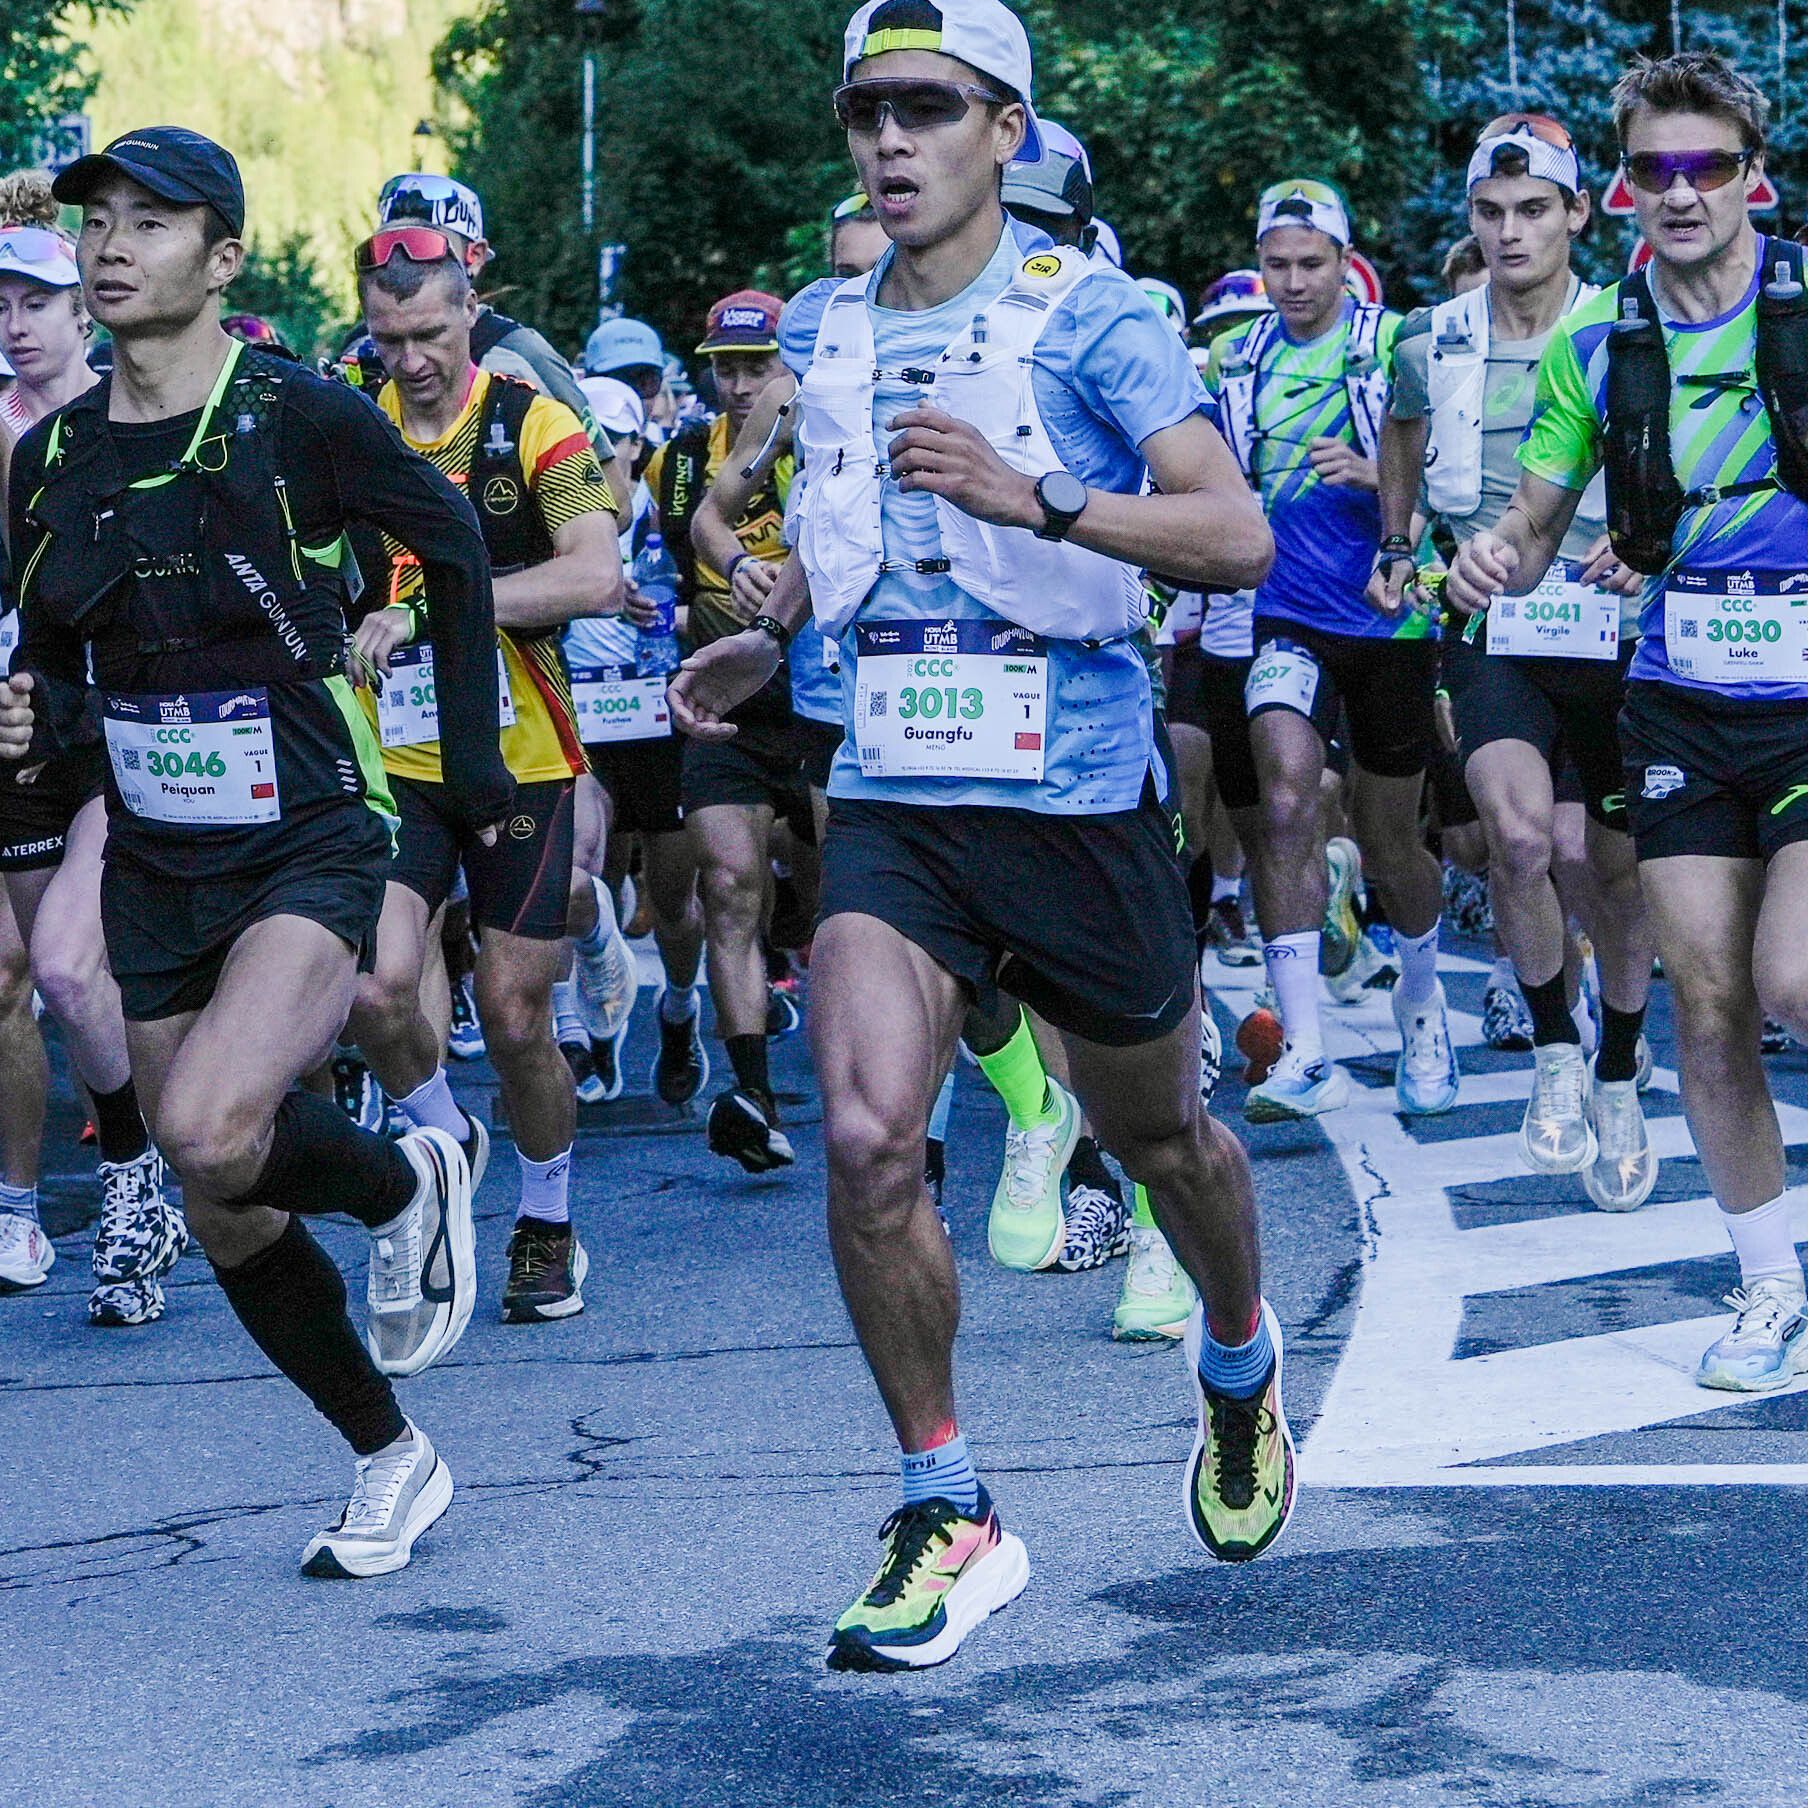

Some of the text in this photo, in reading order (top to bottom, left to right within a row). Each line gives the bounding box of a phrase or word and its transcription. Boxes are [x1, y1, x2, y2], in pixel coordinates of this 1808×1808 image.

[223, 553, 268, 593] ANTA
[1536, 585, 1564, 596] CCC
[1727, 580, 1755, 590] UTMB
[1523, 601, 1581, 623] 3041
[1721, 599, 1753, 613] CCC
[1535, 625, 1570, 637] Virgile
[1706, 618, 1782, 643] 3030
[923, 633, 958, 645] UTMB
[1728, 647, 1759, 658] Luke
[914, 659, 954, 677] CCC
[410, 685, 436, 707] 30
[898, 687, 984, 719] 3013
[1012, 692, 1041, 700] VAGUE
[159, 707, 191, 717] UTMB
[592, 695, 641, 714] 3004
[1024, 704, 1031, 719] 1
[156, 728, 191, 744] CCC
[904, 725, 973, 744] Guangfu
[243, 749, 268, 757] VAGUE
[146, 750, 226, 778] 3046
[254, 760, 262, 773] 1
[161, 782, 216, 798] Peiquan
[11, 834, 64, 858] TERREX
